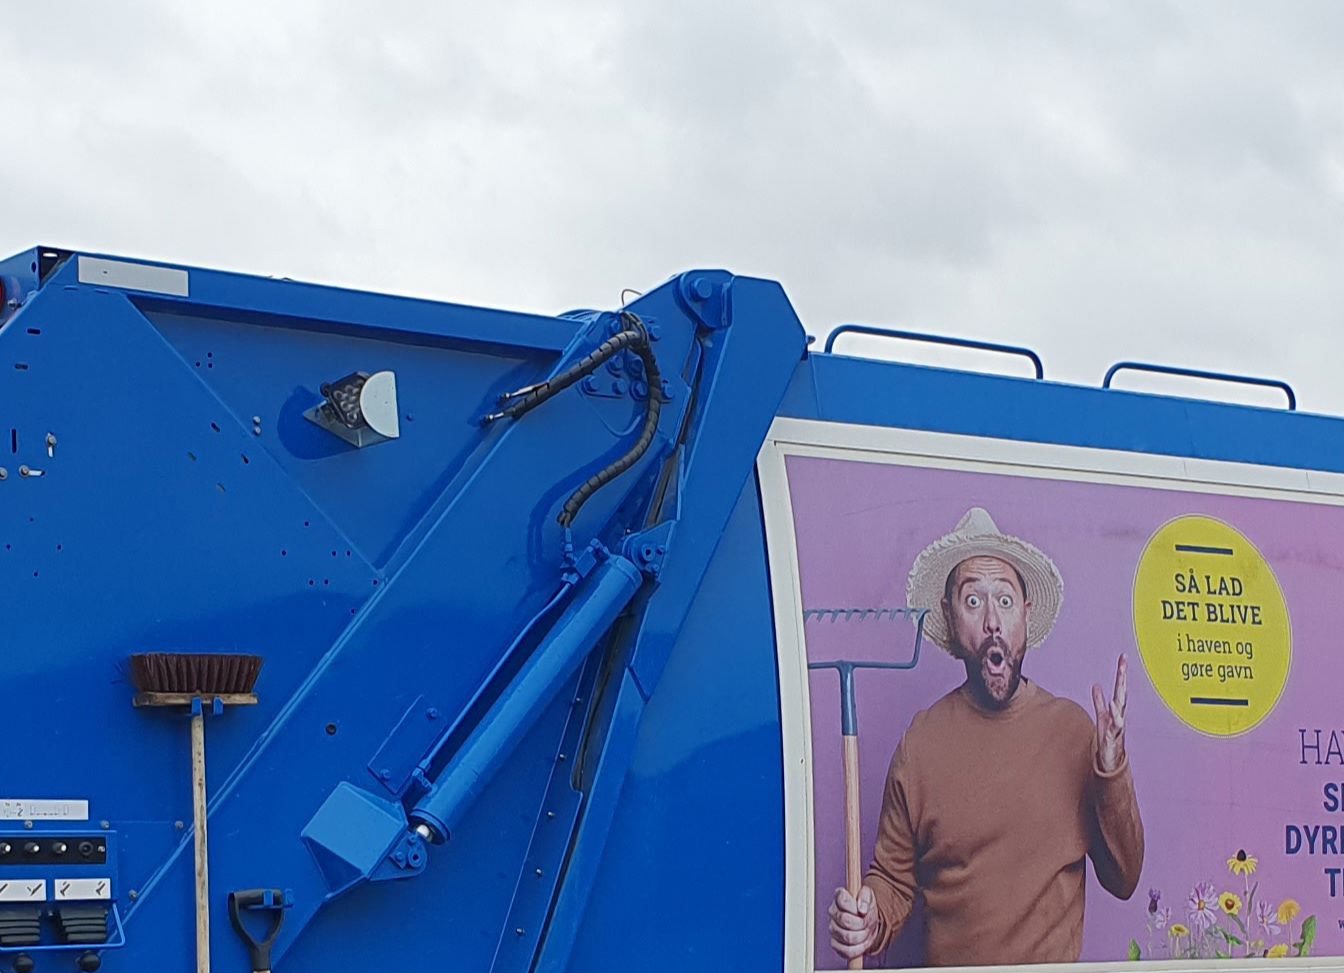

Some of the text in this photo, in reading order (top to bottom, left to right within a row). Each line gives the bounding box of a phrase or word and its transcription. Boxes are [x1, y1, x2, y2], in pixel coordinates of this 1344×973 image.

[1175, 568, 1243, 596] SÅ LAD
[1161, 600, 1262, 625] DET BLIVE
[1177, 633, 1253, 660] i haven og
[1181, 662, 1254, 682] gøre gavn
